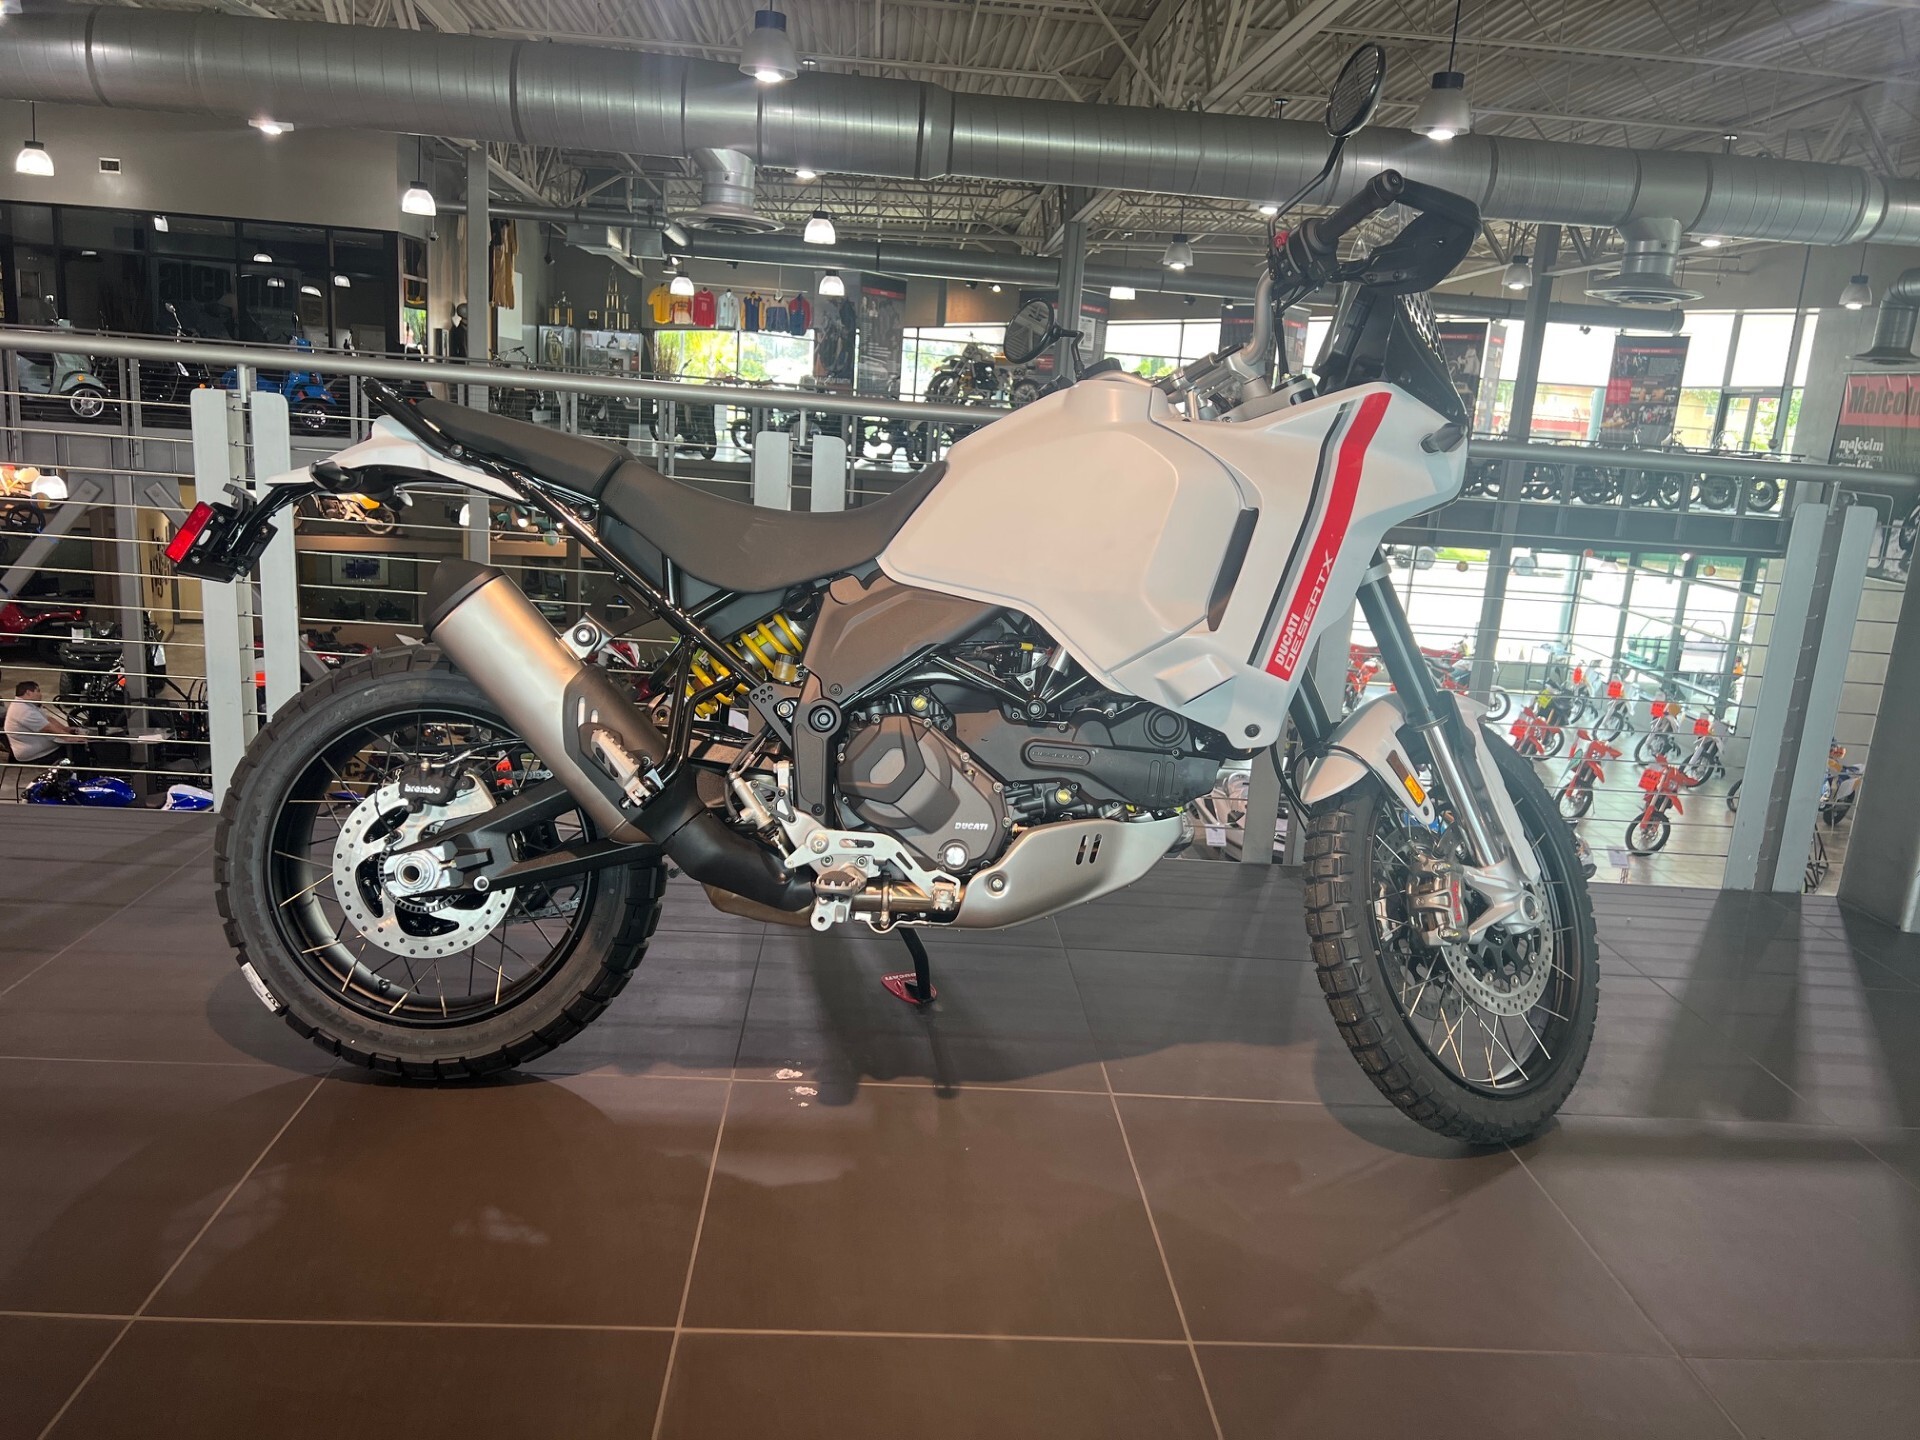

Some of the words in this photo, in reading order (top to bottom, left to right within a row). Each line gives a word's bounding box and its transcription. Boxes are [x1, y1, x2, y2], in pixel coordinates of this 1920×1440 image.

[1839, 436, 1884, 455] malcolm
[1283, 548, 1333, 672] DESERTX
[1274, 612, 1301, 666] DUCATI
[404, 783, 441, 794] brembo
[954, 822, 989, 831] DUCATI
[884, 972, 917, 981] DUCATI
